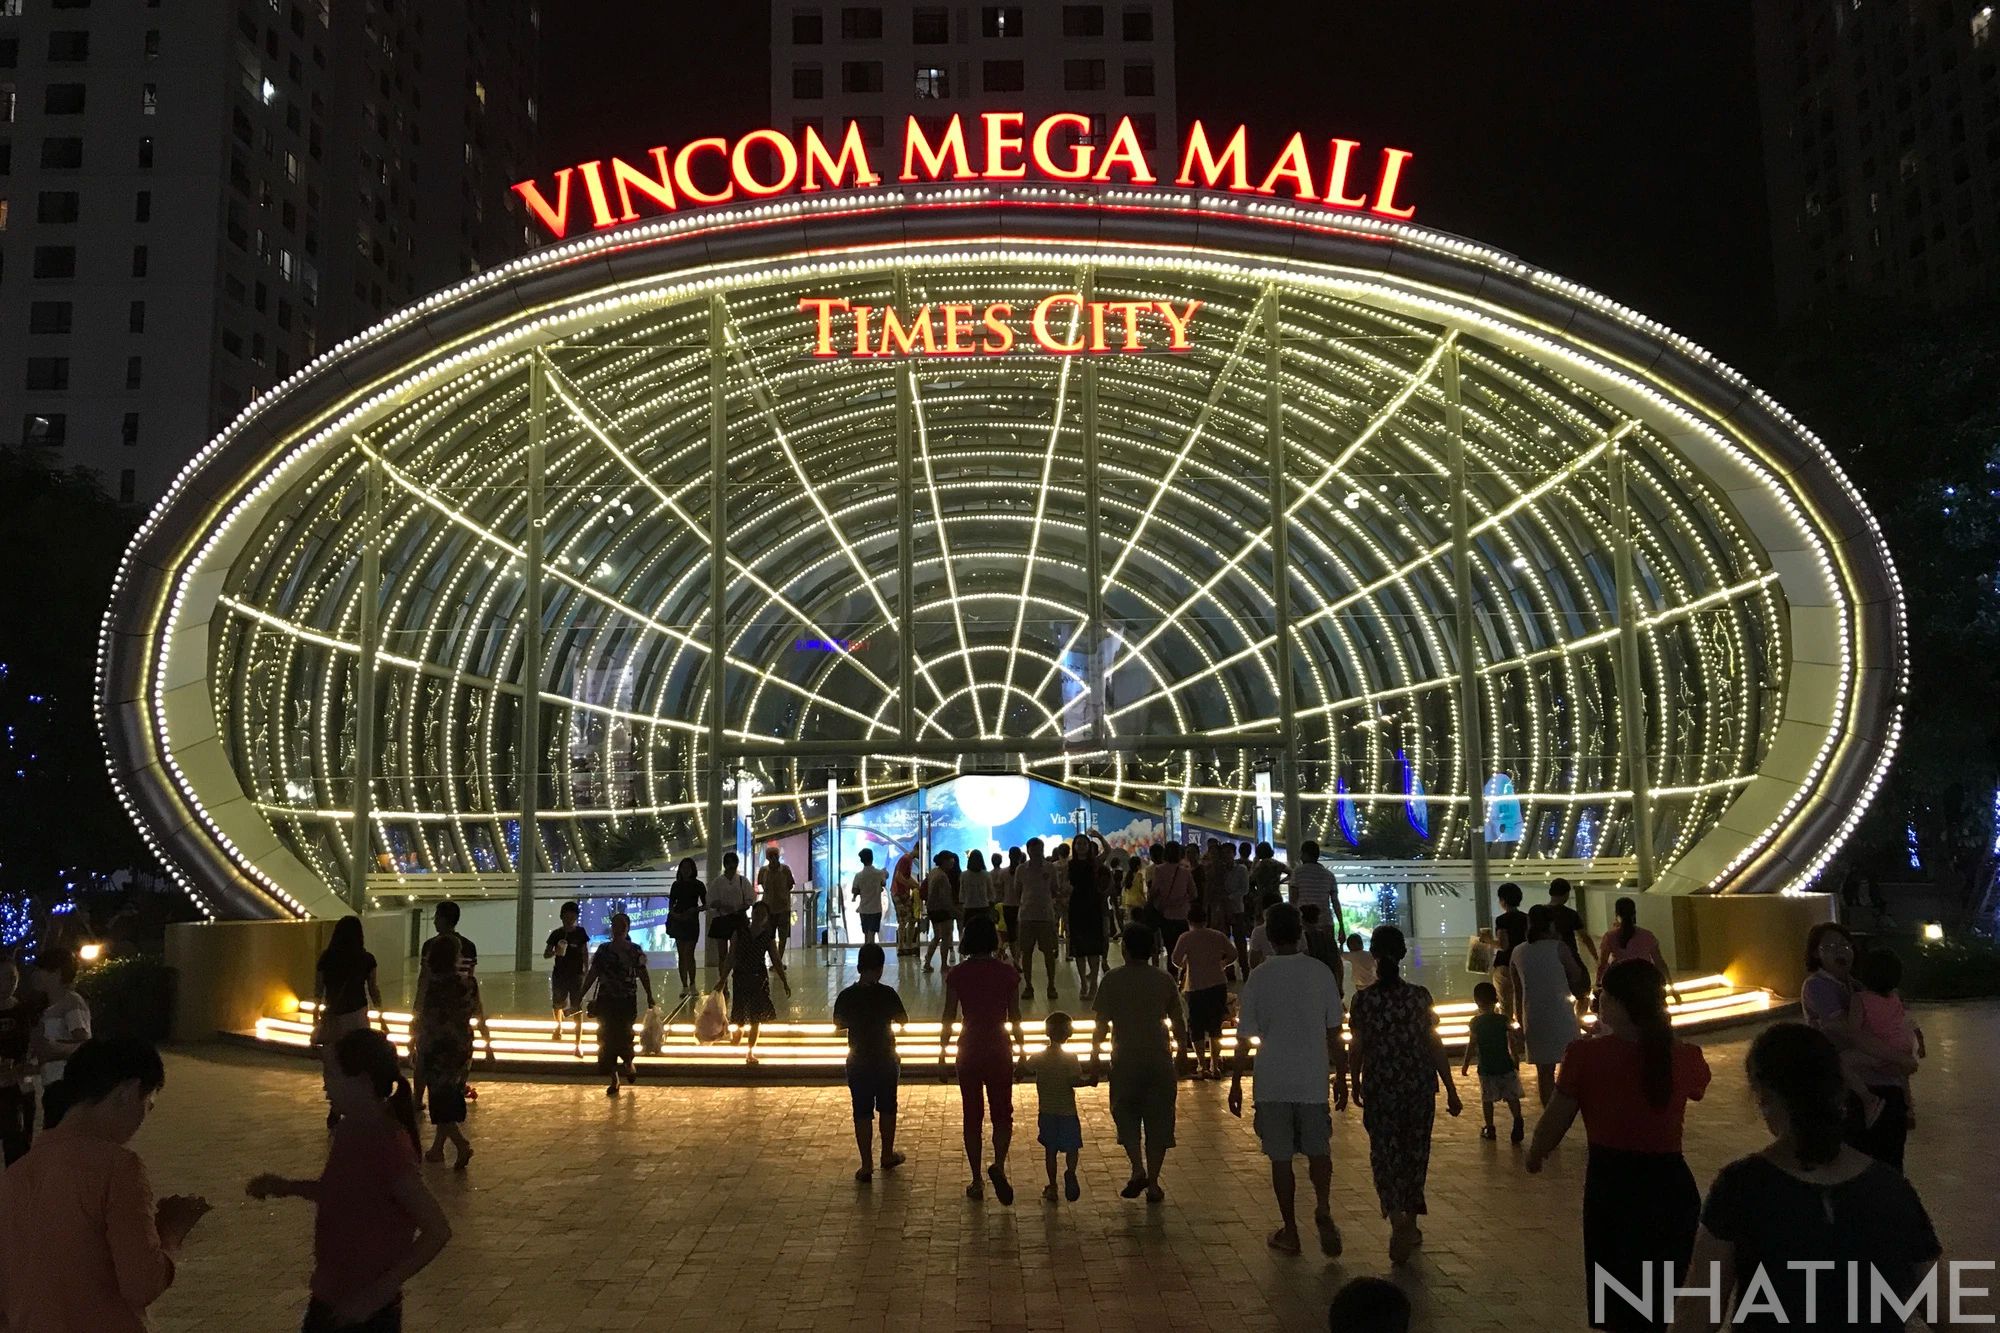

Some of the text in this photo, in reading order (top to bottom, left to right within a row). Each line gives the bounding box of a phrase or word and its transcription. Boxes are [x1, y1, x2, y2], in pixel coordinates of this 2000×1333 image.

[511, 112, 1416, 238] VINCOM MEGA MALL
[799, 293, 1203, 356] TIMES CITY
